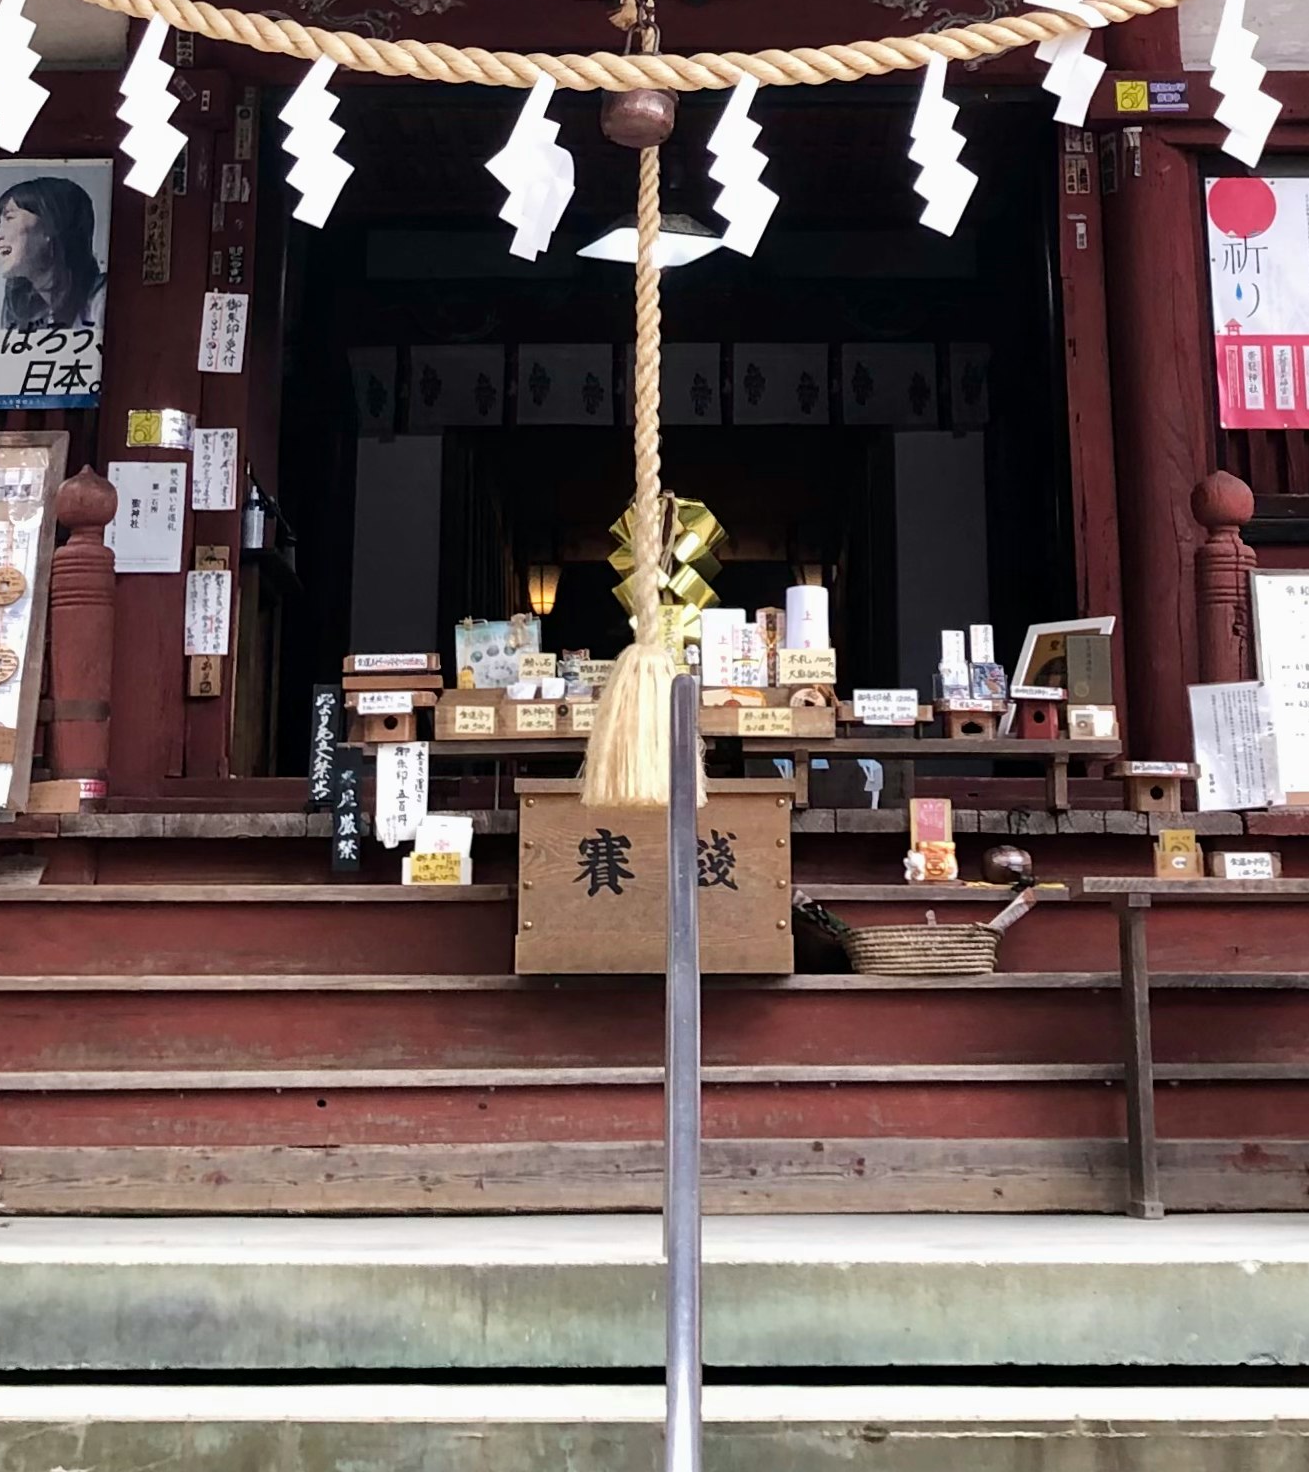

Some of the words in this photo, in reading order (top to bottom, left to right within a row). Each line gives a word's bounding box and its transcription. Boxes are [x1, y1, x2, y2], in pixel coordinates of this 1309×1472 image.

[1222, 235, 1269, 319] 祈り
[223, 297, 243, 368] 御朱印受付
[20, 359, 102, 396] 日本。
[130, 498, 143, 529] 聖神社
[167, 468, 180, 531] 秩父願い石巡礼
